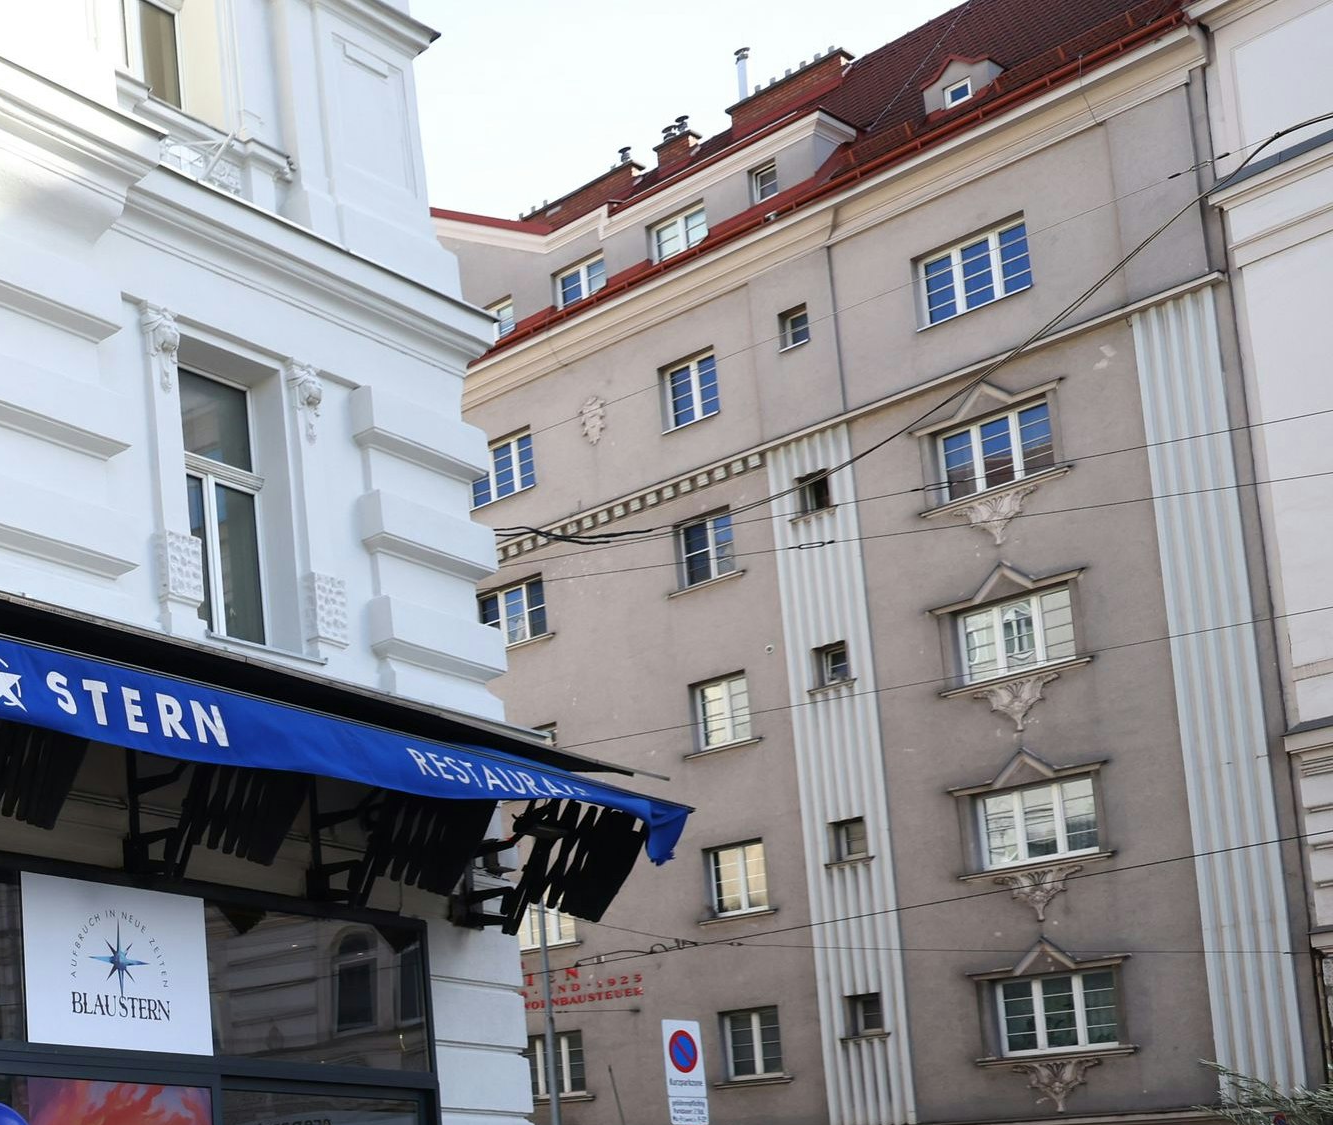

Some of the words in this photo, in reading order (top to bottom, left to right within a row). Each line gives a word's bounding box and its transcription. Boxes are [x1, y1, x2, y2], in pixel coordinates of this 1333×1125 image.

[45, 670, 230, 748] STERN
[69, 913, 101, 978] AUFBRUCH
[105, 909, 117, 919] IN
[121, 911, 147, 934] NEUE
[148, 937, 169, 988] ZEITEN
[71, 991, 171, 1022] BLAUSTERN
